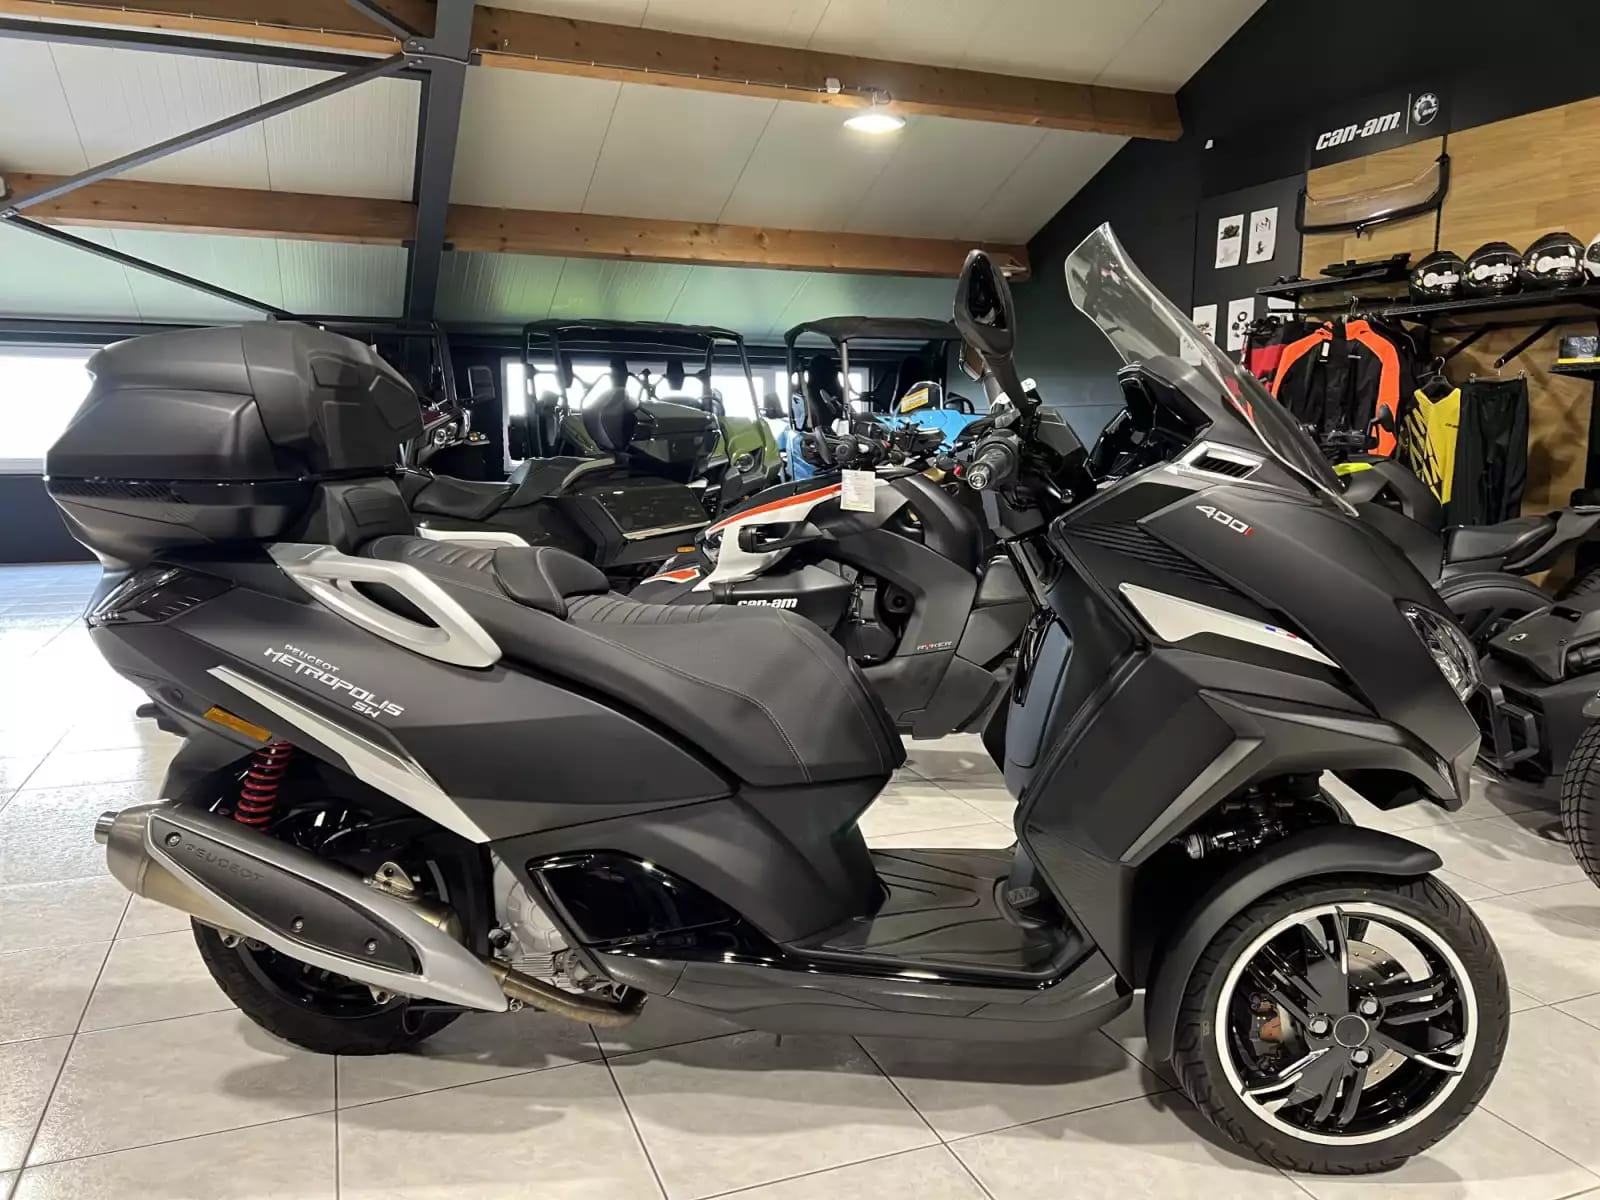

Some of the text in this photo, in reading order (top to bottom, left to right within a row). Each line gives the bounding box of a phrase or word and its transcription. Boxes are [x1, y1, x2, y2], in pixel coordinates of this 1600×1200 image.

[1315, 111, 1401, 150] can-am
[284, 644, 340, 673] PEUGEOT
[264, 647, 404, 717] METROPOLIS
[352, 701, 381, 718] SW
[184, 843, 264, 880] PEUGEOT
